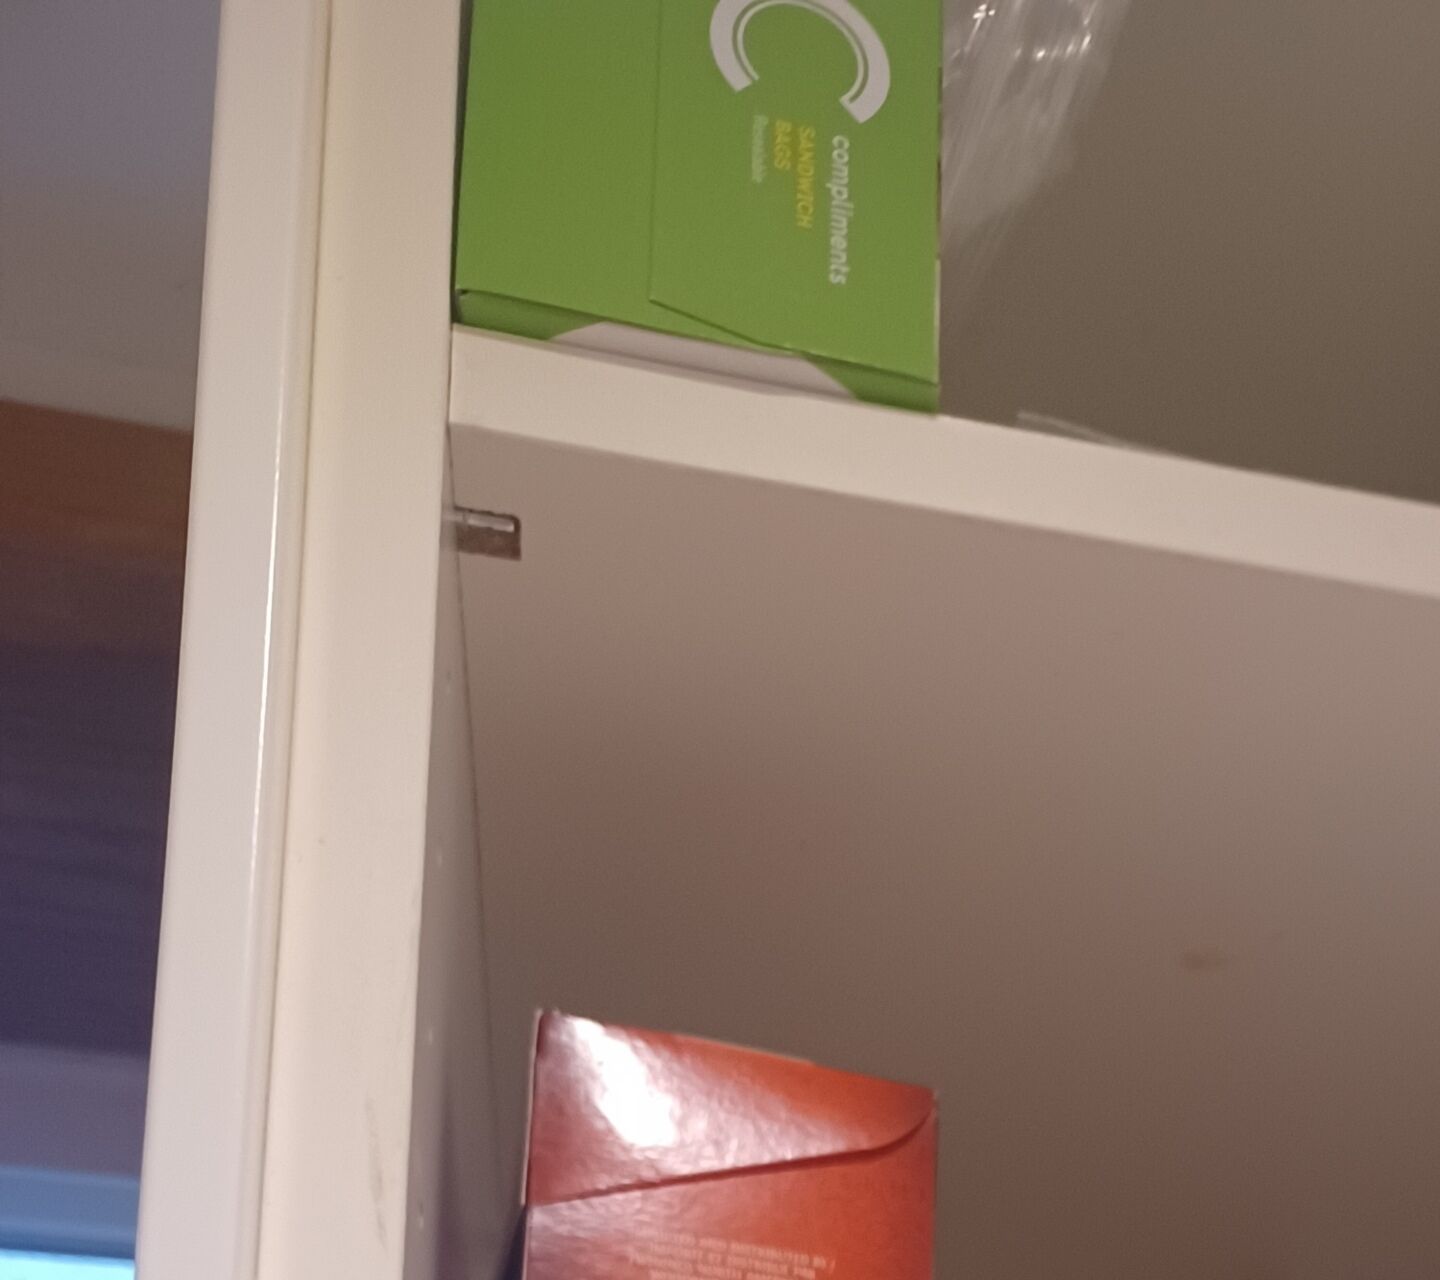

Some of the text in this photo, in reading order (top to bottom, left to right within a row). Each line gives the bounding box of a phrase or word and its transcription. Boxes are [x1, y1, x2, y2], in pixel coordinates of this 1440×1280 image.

[774, 120, 792, 170] BAGS
[797, 126, 816, 228] SANDWICH
[826, 135, 854, 284] compliments
